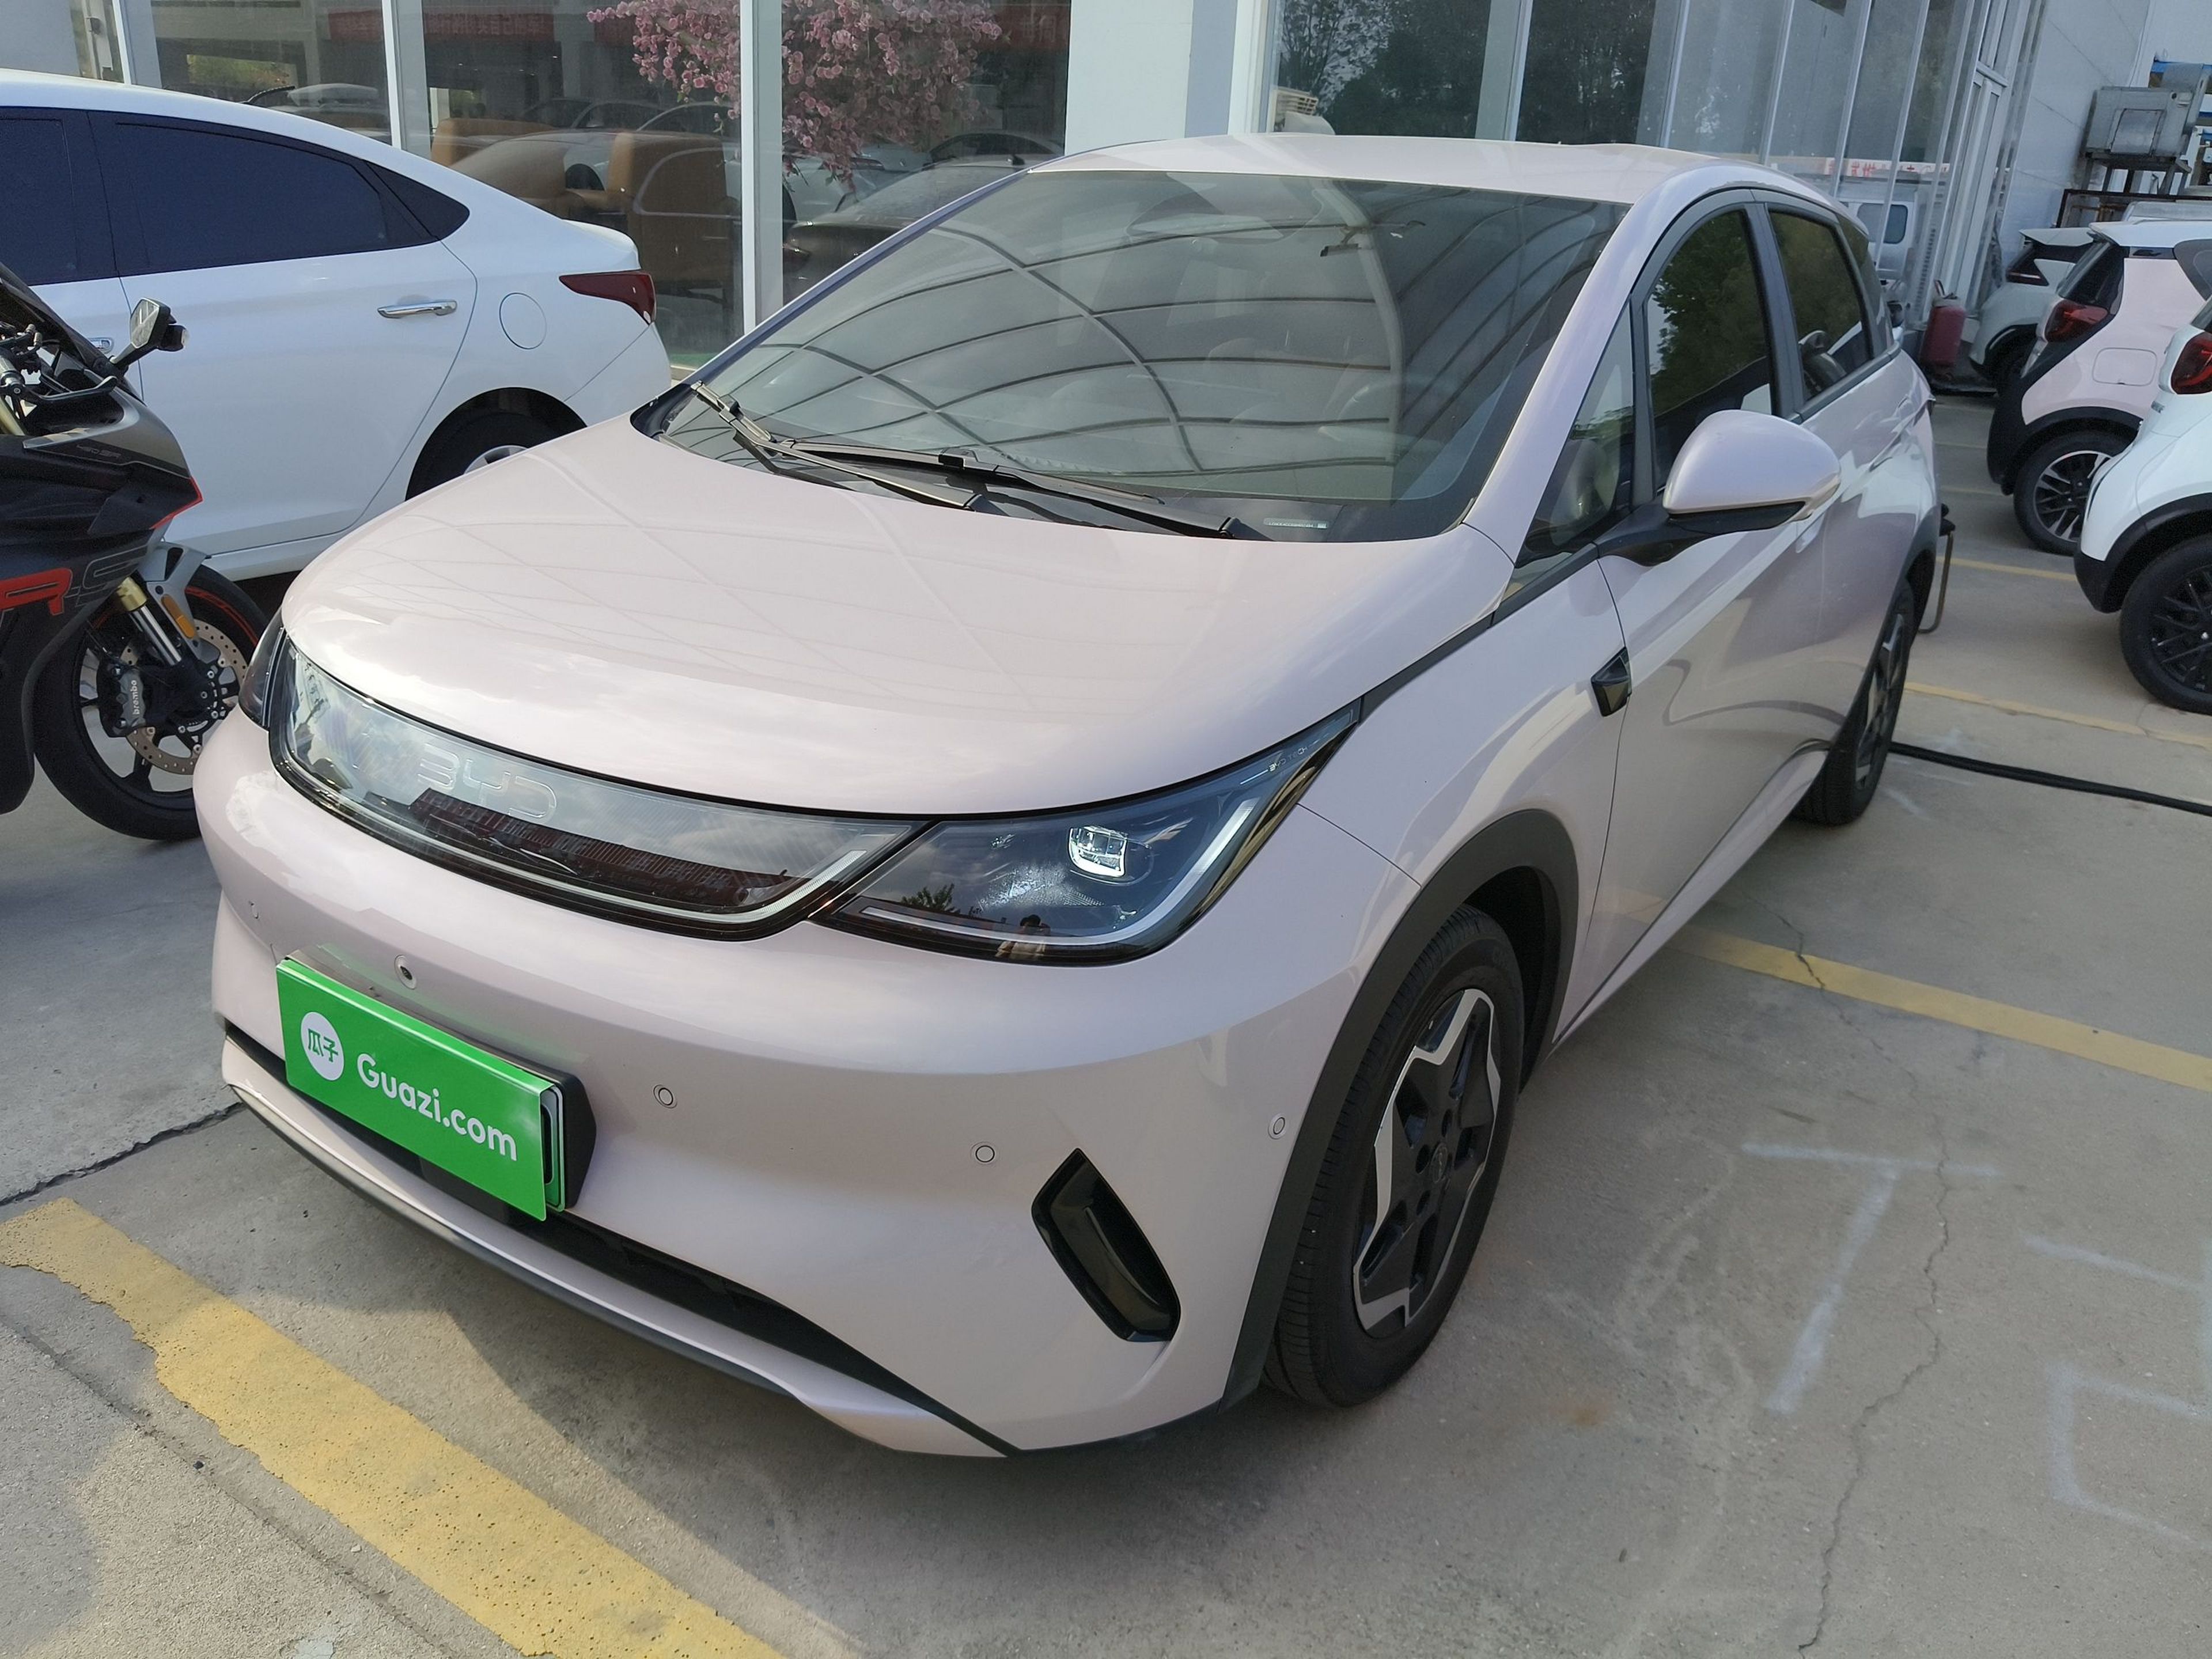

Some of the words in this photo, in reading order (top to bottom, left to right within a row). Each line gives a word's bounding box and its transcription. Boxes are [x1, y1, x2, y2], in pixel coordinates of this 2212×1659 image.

[130, 680, 140, 714] brembo
[308, 1028, 339, 1063] 瓜子
[357, 1053, 517, 1161] Guazi.com
